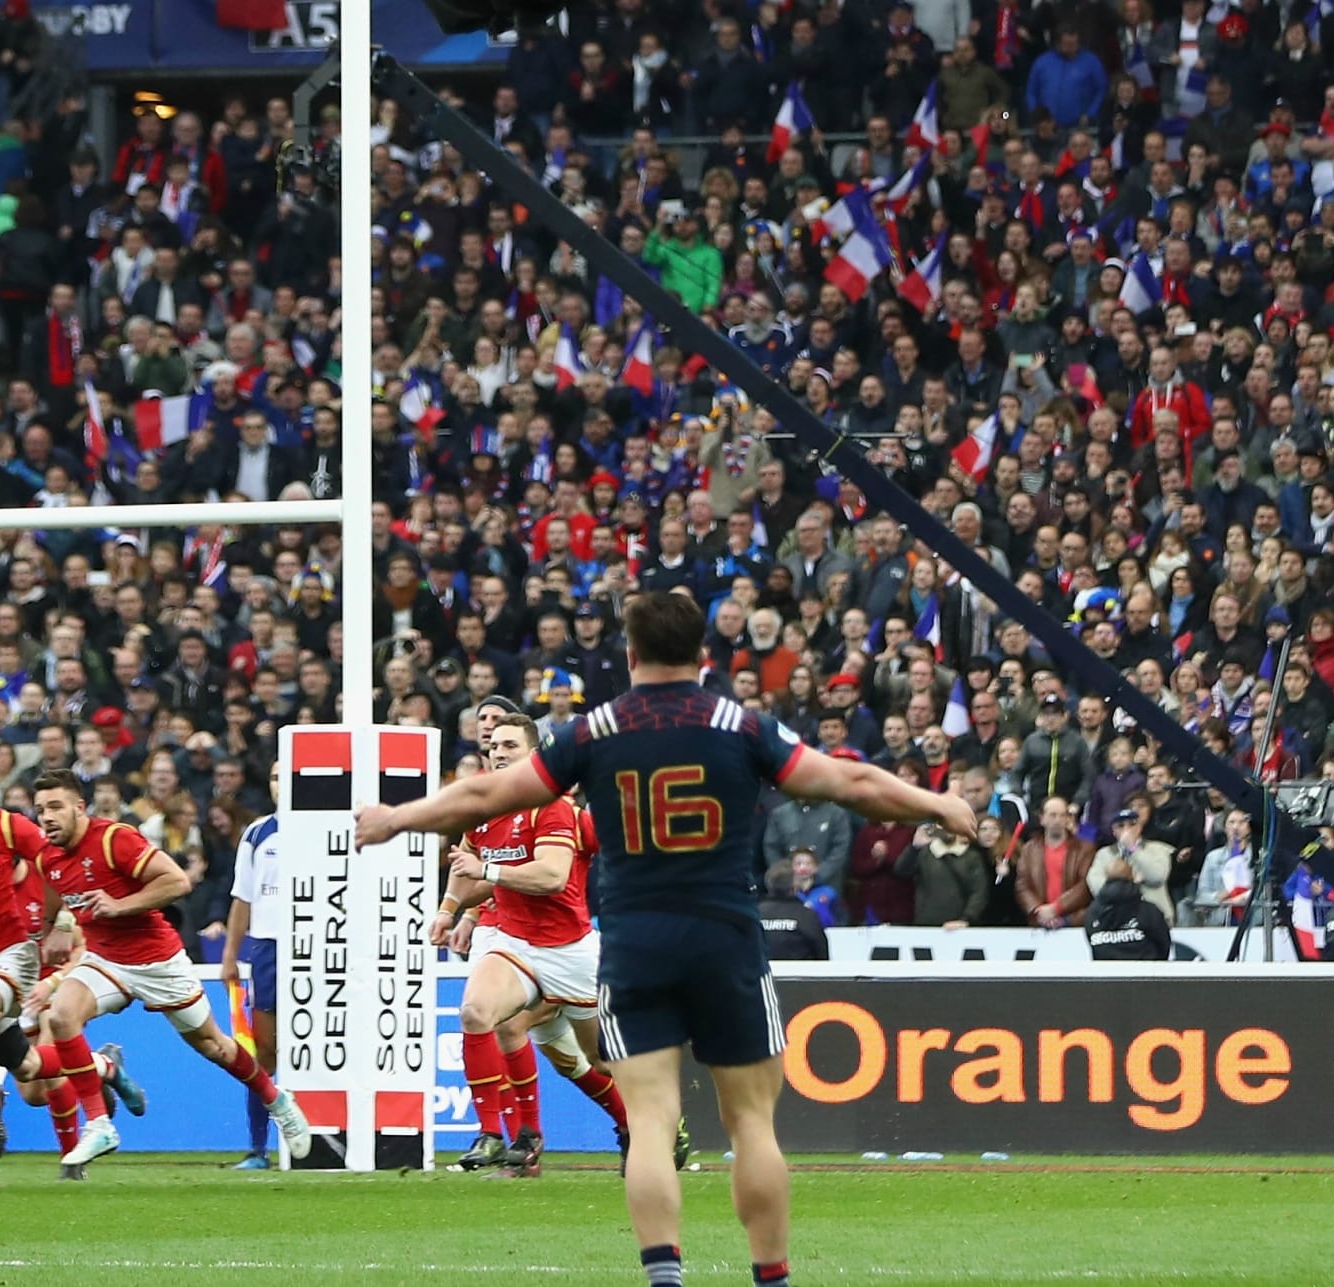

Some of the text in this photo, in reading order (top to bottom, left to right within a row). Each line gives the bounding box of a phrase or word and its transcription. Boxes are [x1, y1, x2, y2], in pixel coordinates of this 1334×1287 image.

[489, 846, 526, 860] Admiral
[615, 764, 723, 854] 16
[291, 876, 315, 1071] SOCIETE
[324, 829, 350, 1072] GENERALE
[376, 876, 398, 1072] SOCIETE
[404, 831, 425, 1072] GENERALE
[783, 1001, 1292, 1131] Orange
